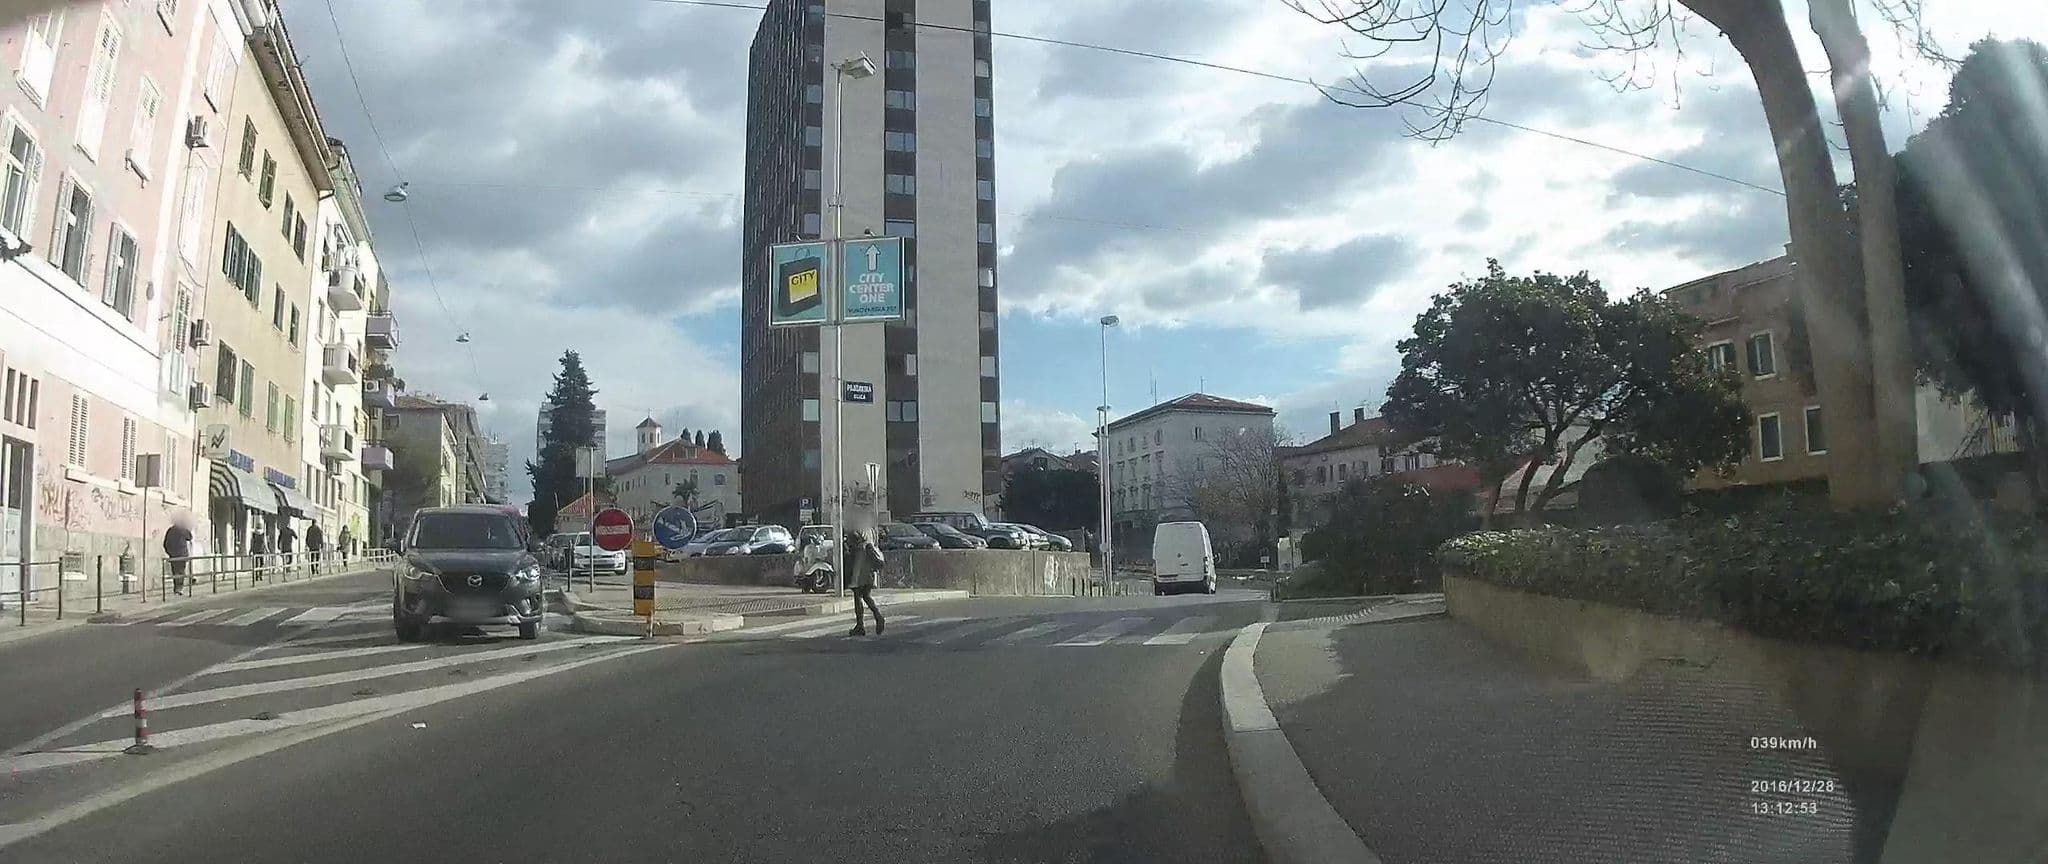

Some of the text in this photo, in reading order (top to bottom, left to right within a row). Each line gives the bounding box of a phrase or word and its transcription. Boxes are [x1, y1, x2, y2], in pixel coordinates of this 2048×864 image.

[791, 271, 816, 286] CITY
[859, 272, 885, 284] CITY
[849, 283, 895, 294] CENTER
[859, 293, 885, 304] ONE
